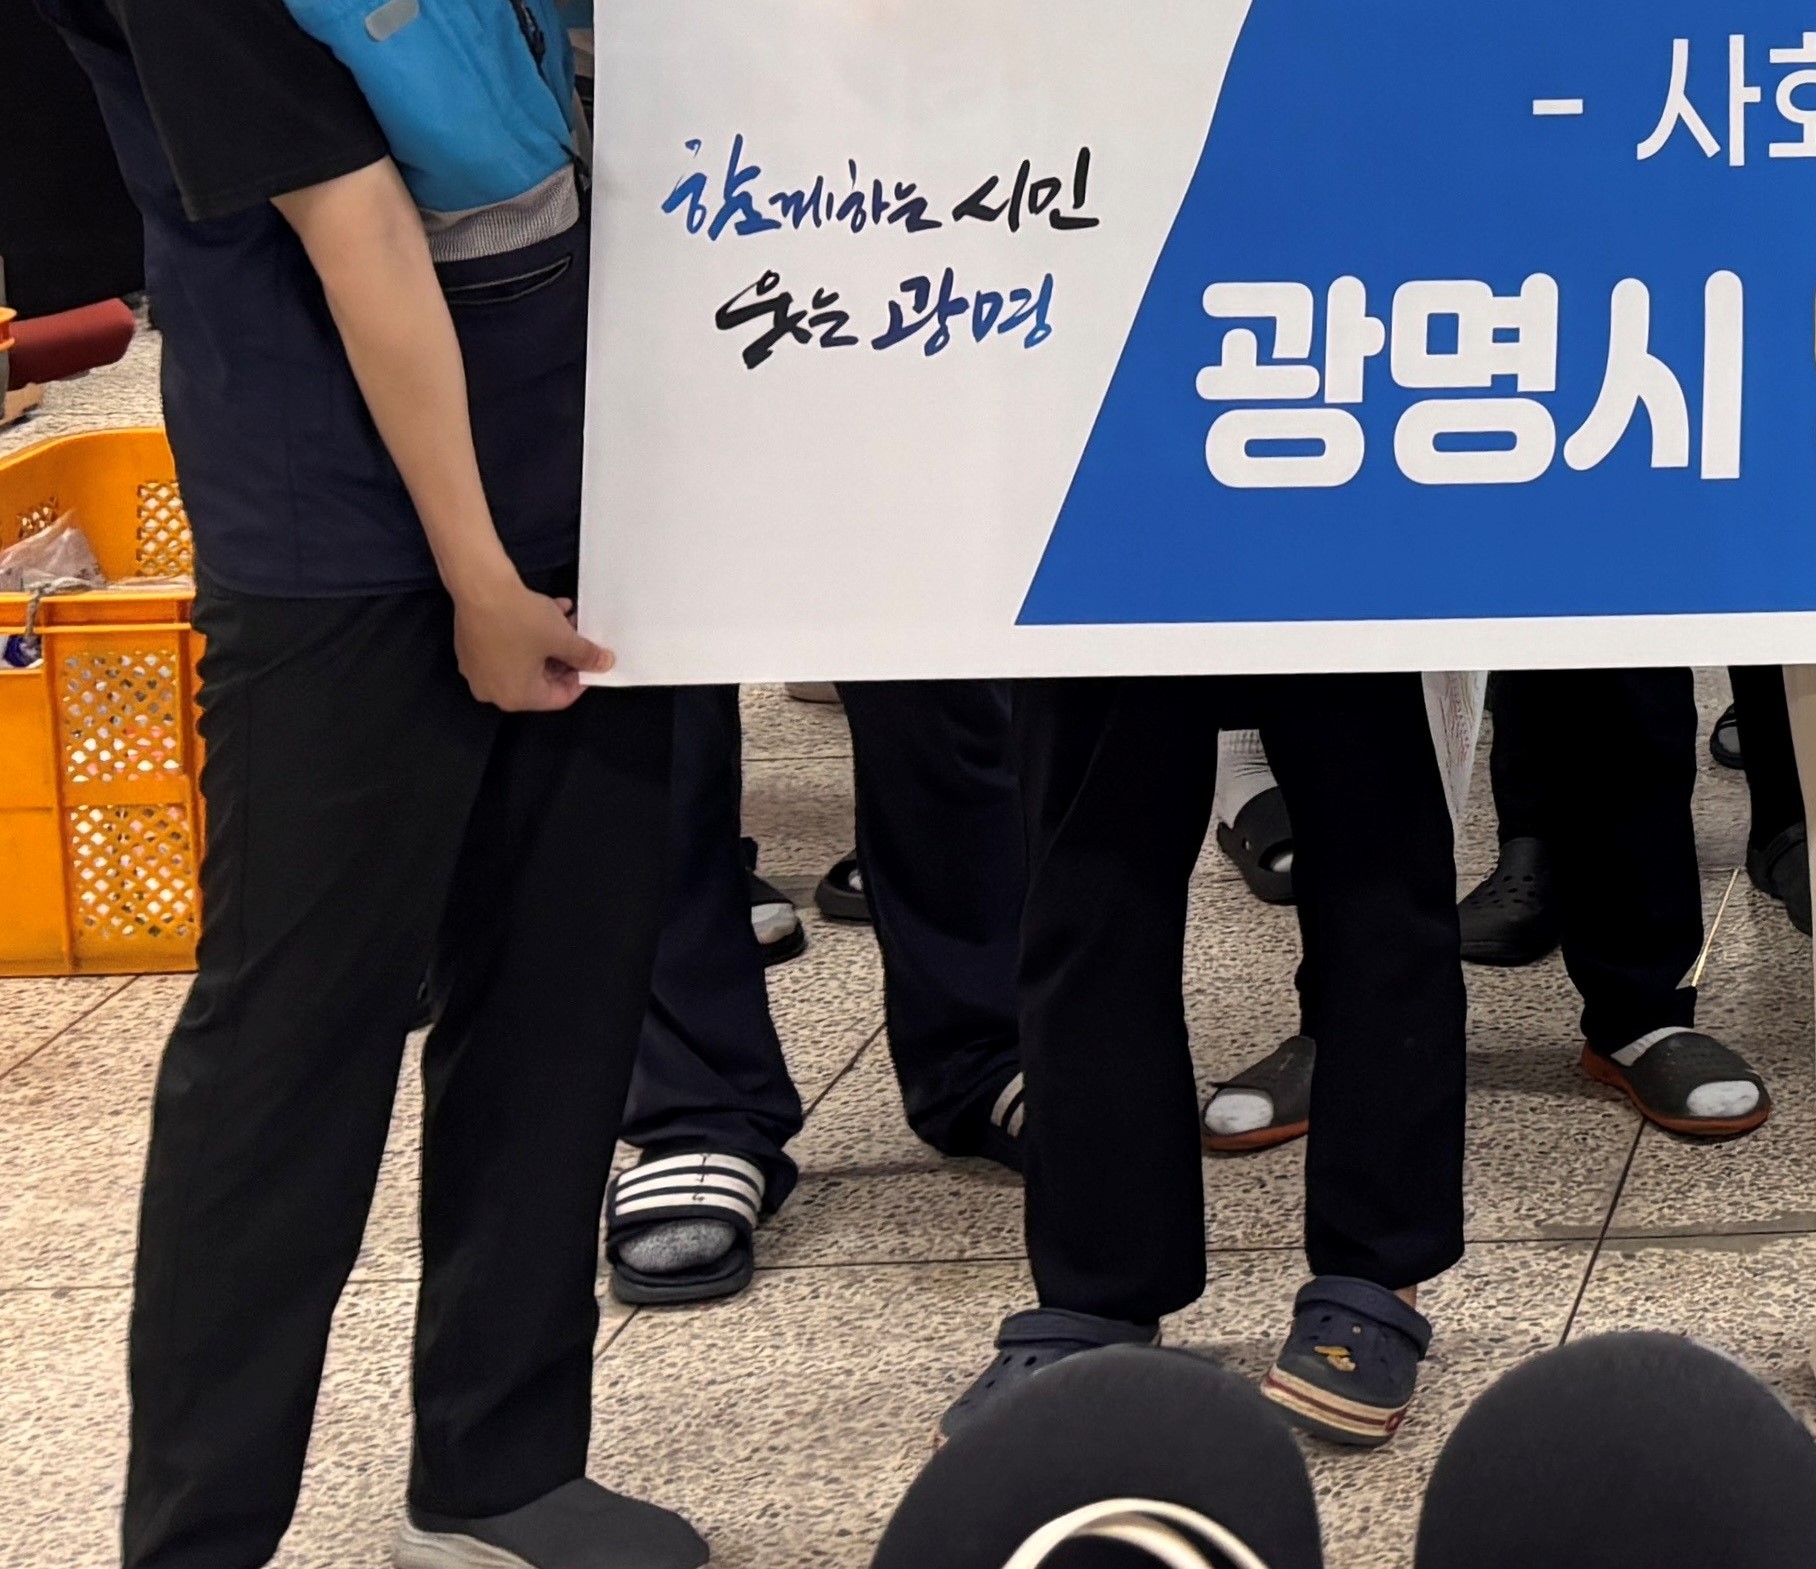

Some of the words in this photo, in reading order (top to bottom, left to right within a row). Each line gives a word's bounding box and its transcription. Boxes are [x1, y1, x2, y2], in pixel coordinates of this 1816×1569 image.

[661, 133, 942, 241] 함께하는
[952, 146, 1100, 233] 시민
[715, 269, 859, 370] 웃는
[871, 267, 1054, 357] 광명
[1196, 269, 1744, 489] 광명시
